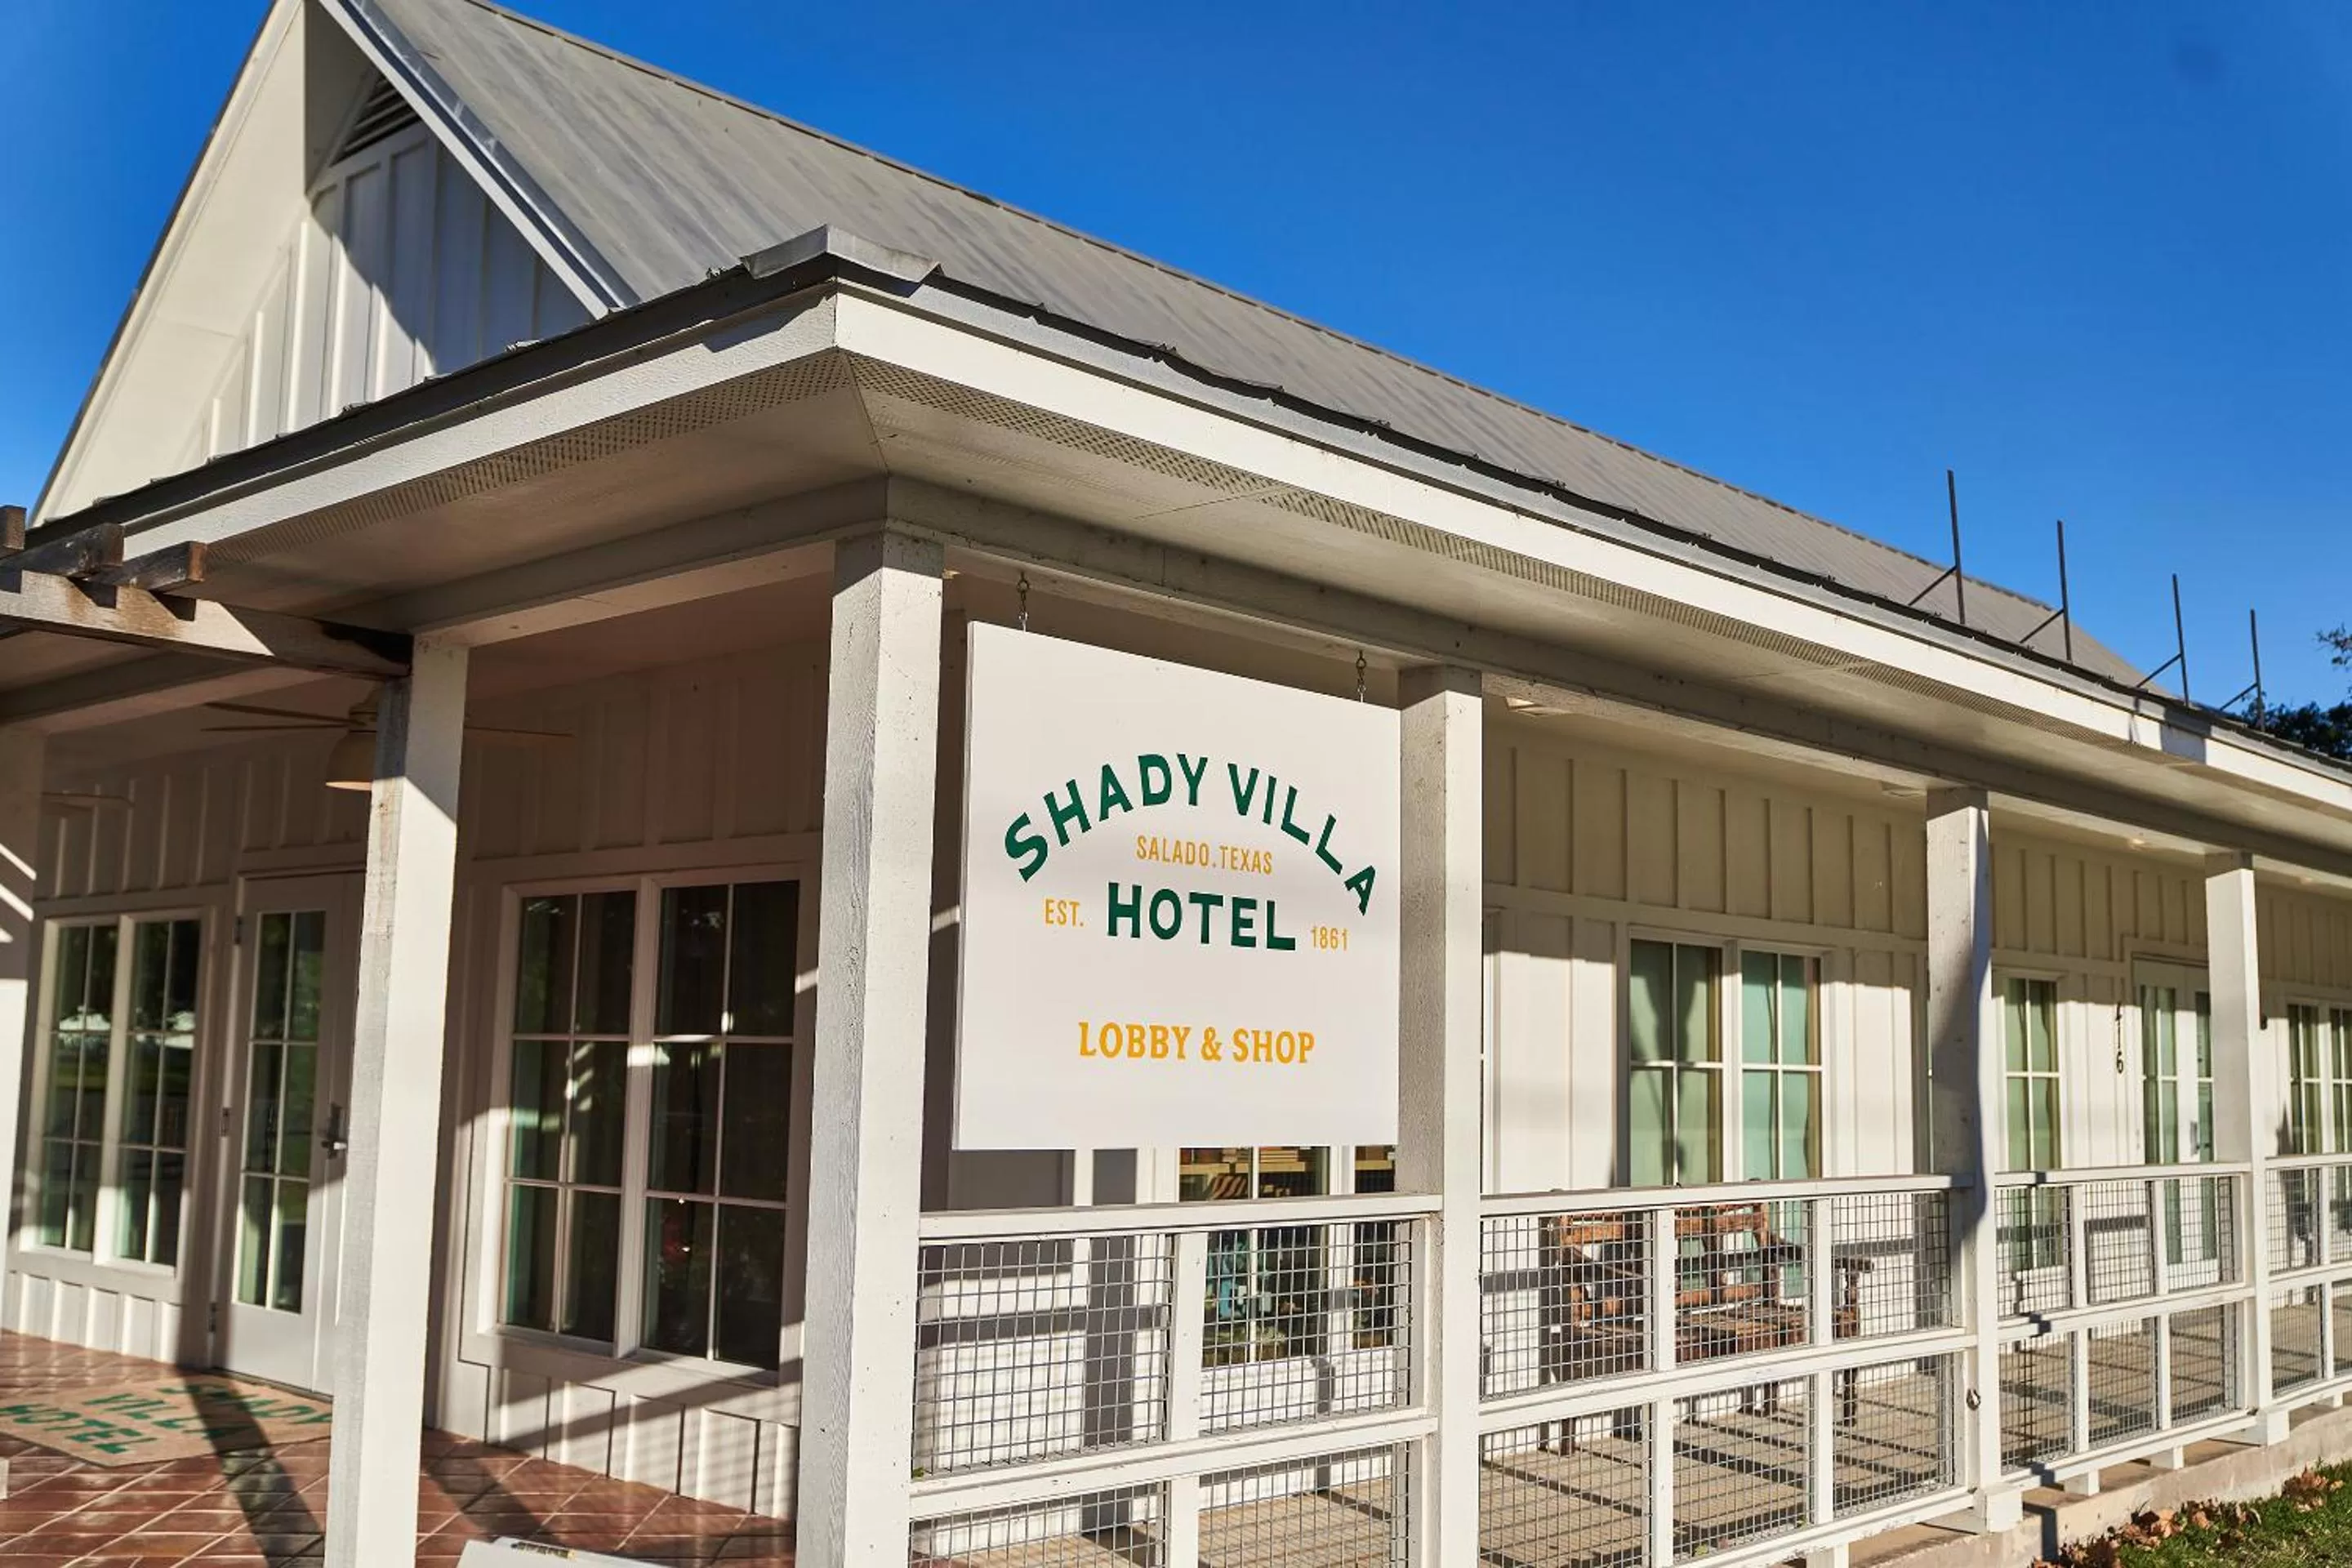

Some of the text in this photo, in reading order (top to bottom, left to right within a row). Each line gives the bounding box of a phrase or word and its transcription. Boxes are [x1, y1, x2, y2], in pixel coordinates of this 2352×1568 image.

[1005, 753, 1375, 915] SHADY VILLA
[1045, 882, 1348, 951] EST. HOTEL 1861
[1079, 1021, 1316, 1066] LOBBY & SHOP
